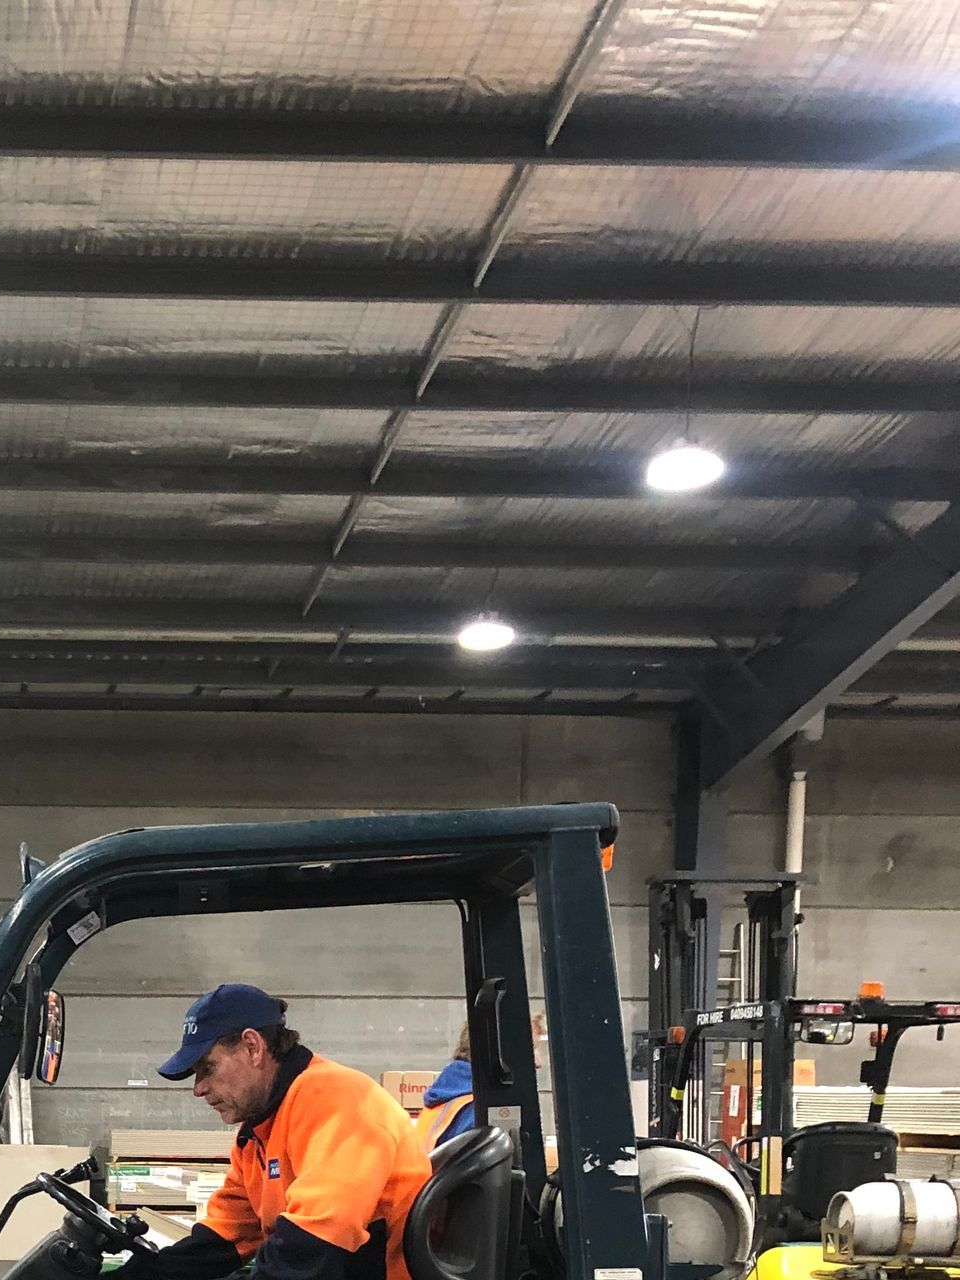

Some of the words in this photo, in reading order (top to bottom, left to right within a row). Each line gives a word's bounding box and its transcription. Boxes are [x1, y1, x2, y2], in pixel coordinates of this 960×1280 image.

[697, 1012, 709, 1026] FOR
[710, 1010, 724, 1025] HIRE
[399, 1083, 430, 1093] Rinn
